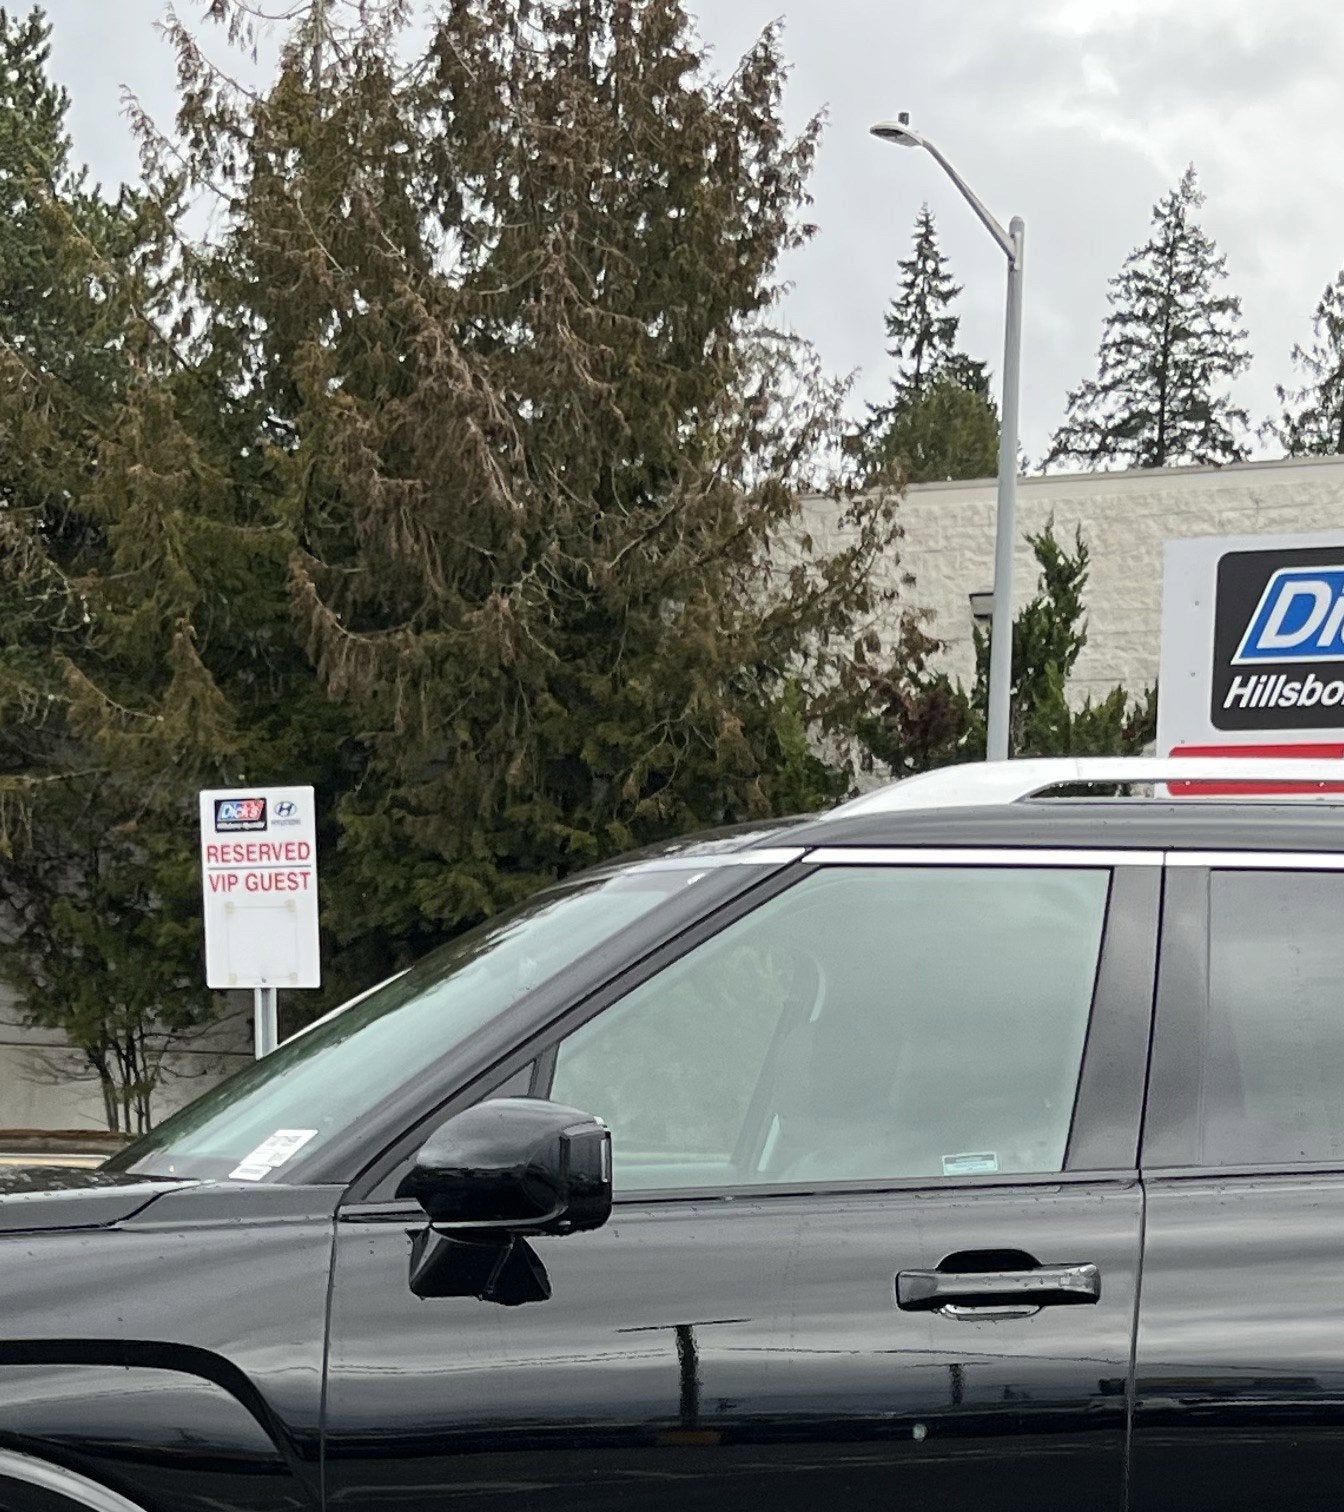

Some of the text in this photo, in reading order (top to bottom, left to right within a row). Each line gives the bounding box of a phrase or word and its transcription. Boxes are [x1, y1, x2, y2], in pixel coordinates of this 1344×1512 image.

[207, 842, 311, 863] RESERVED
[209, 872, 311, 892] VIP GUEST
